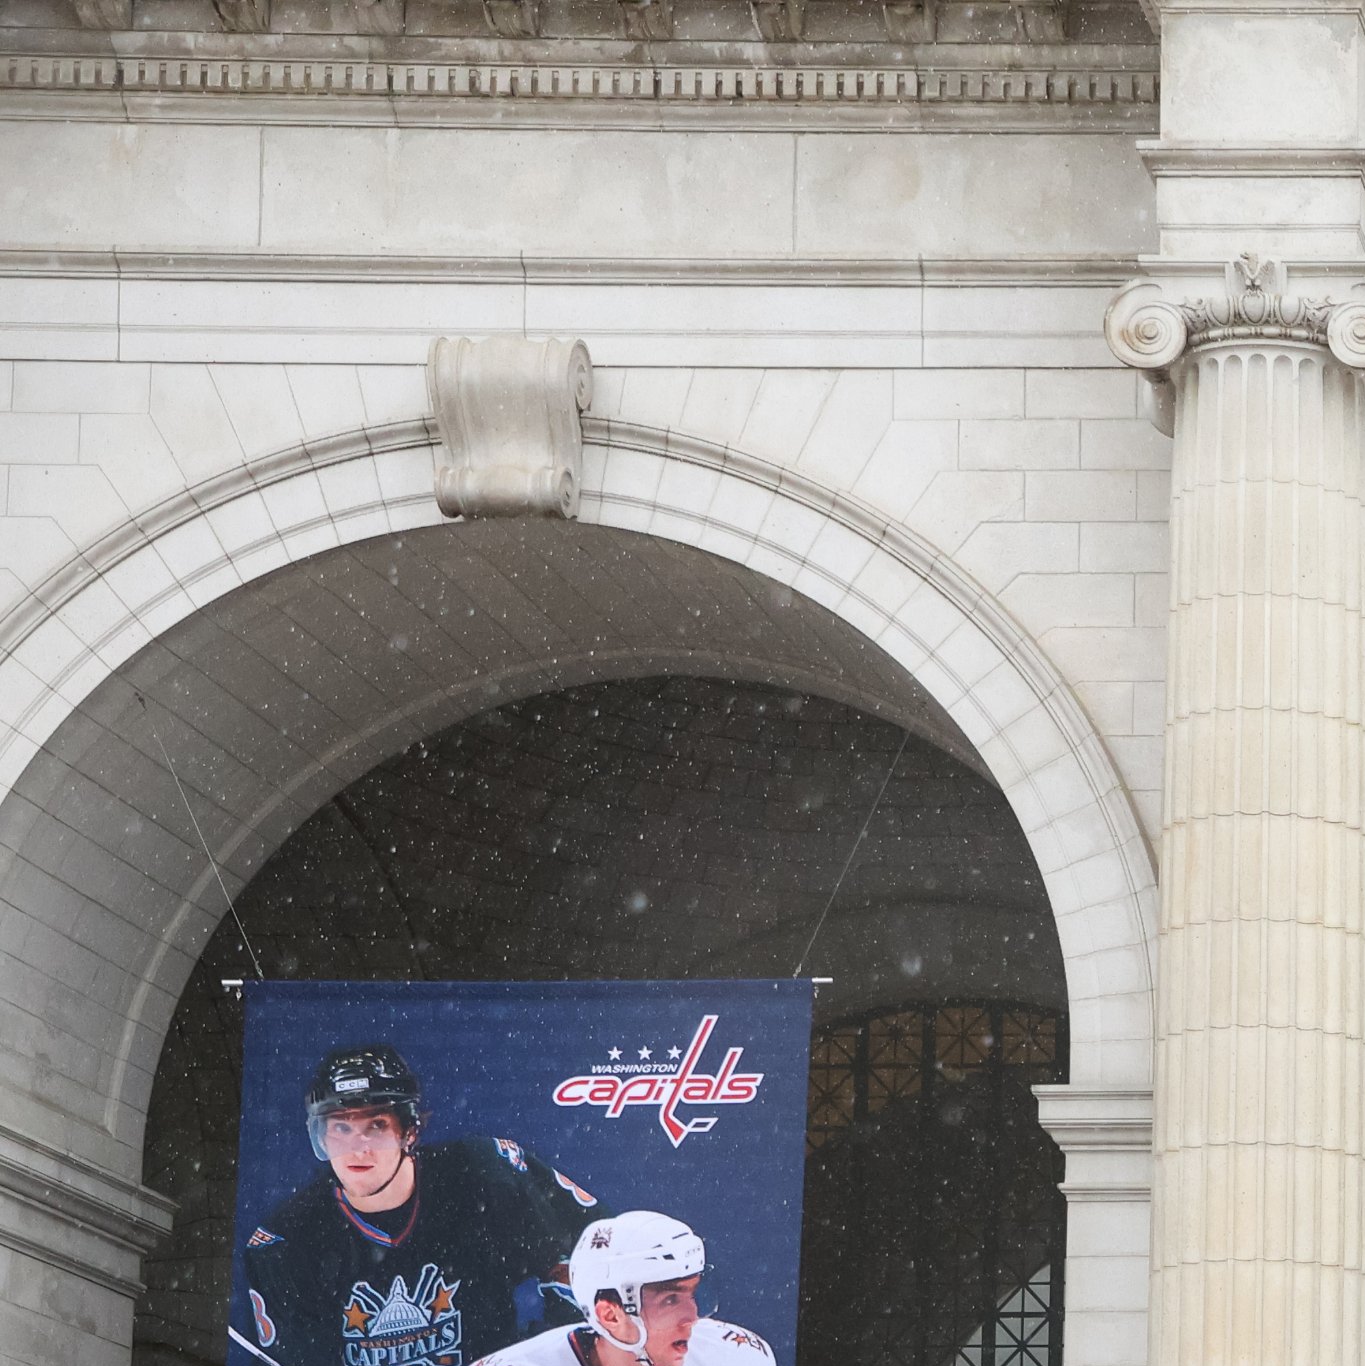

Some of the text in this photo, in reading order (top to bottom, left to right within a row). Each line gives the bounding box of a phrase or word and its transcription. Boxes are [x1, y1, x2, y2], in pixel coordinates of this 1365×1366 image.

[553, 1015, 764, 1148] capitals
[591, 1063, 678, 1074] WASHINGTON
[345, 1321, 456, 1366] CAPITALS
